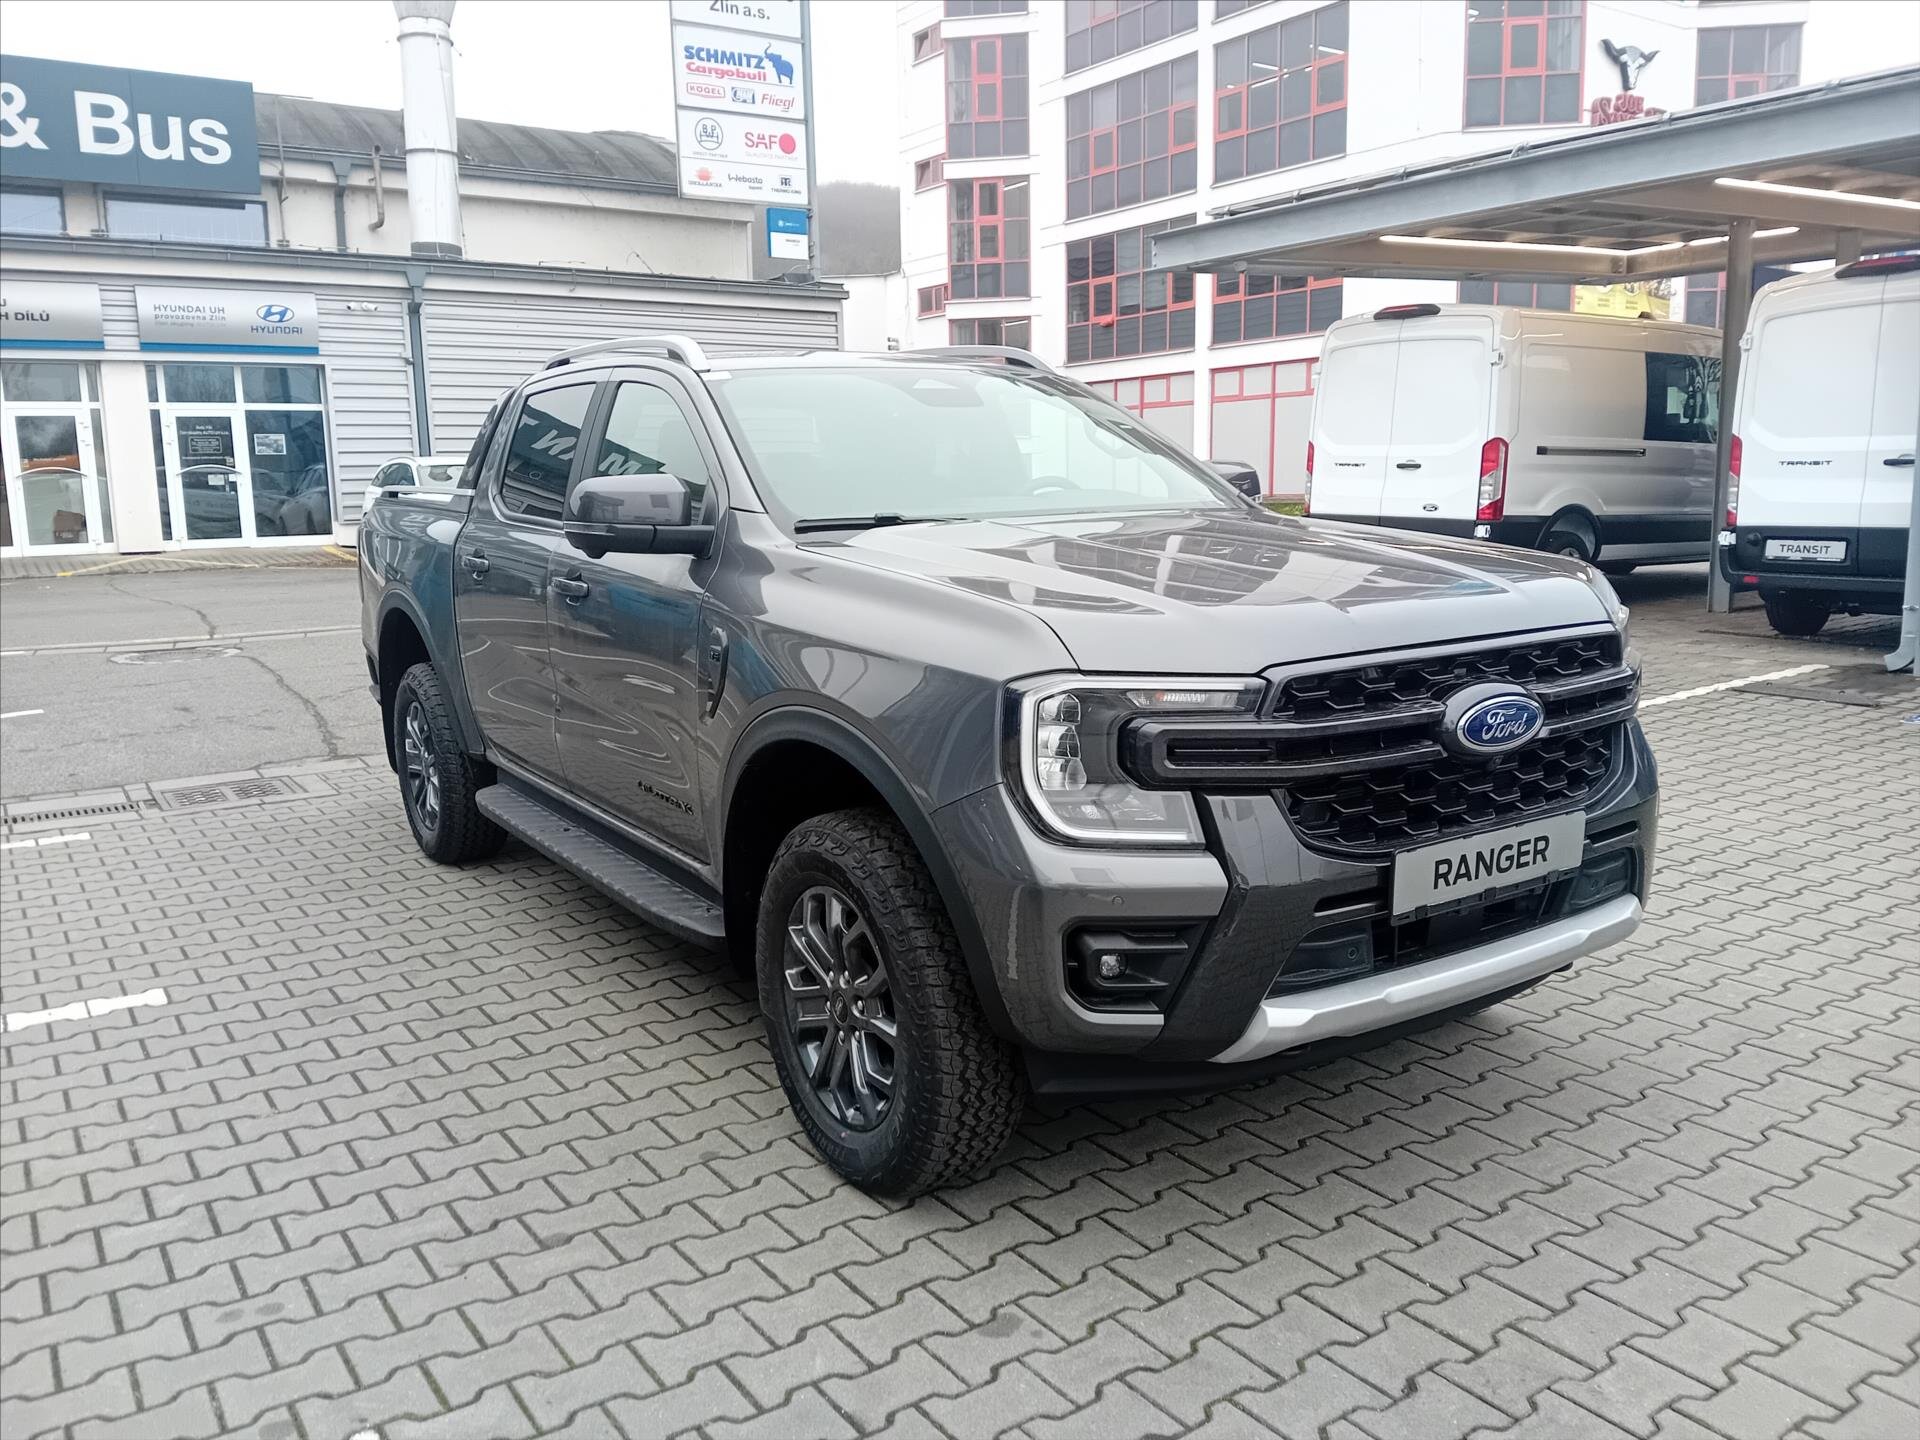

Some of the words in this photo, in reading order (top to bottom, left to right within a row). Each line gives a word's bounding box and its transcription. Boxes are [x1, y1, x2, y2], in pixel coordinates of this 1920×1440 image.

[743, 5, 771, 20] a.s.
[683, 45, 766, 70] SCHMITZ
[686, 61, 767, 81] Cargobull
[761, 93, 795, 110] Fliegl
[0, 82, 49, 150] &
[74, 90, 232, 165] Bus
[728, 173, 763, 184] Webasto
[14, 310, 50, 322] DÍLŮ
[153, 303, 206, 313] HYUNDAI
[209, 306, 225, 314] UH
[250, 325, 303, 335] HYUNDAI
[1780, 543, 1831, 556] TRANSIT
[1482, 708, 1528, 740] Ford
[1433, 835, 1550, 890] RANGER
